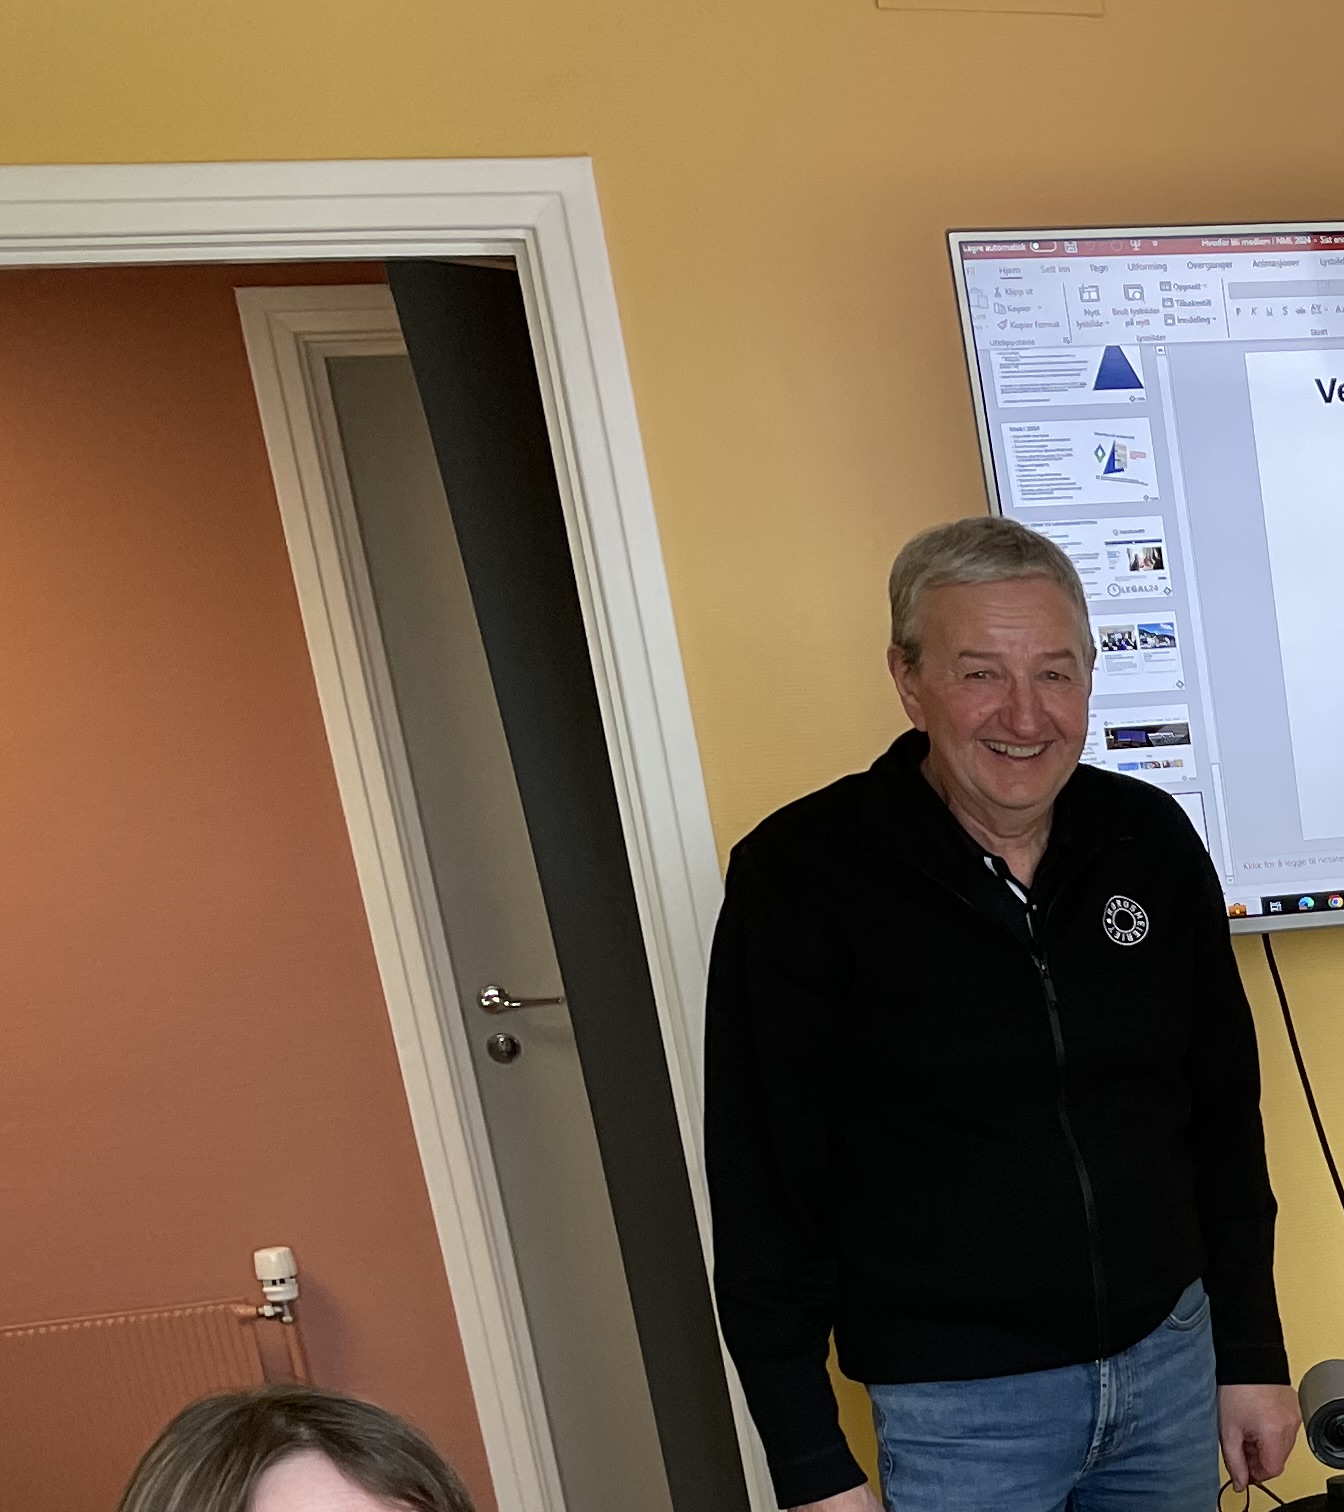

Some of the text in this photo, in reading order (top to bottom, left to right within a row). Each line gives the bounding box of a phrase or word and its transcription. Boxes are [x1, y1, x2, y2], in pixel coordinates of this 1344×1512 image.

[1089, 264, 1109, 274] Tegn
[1127, 262, 1168, 273] Utforming
[1186, 260, 1234, 271] Overganger
[1252, 258, 1300, 269] Animasjoner
[998, 266, 1021, 277] Hjem
[1040, 265, 1070, 274] Sett inn
